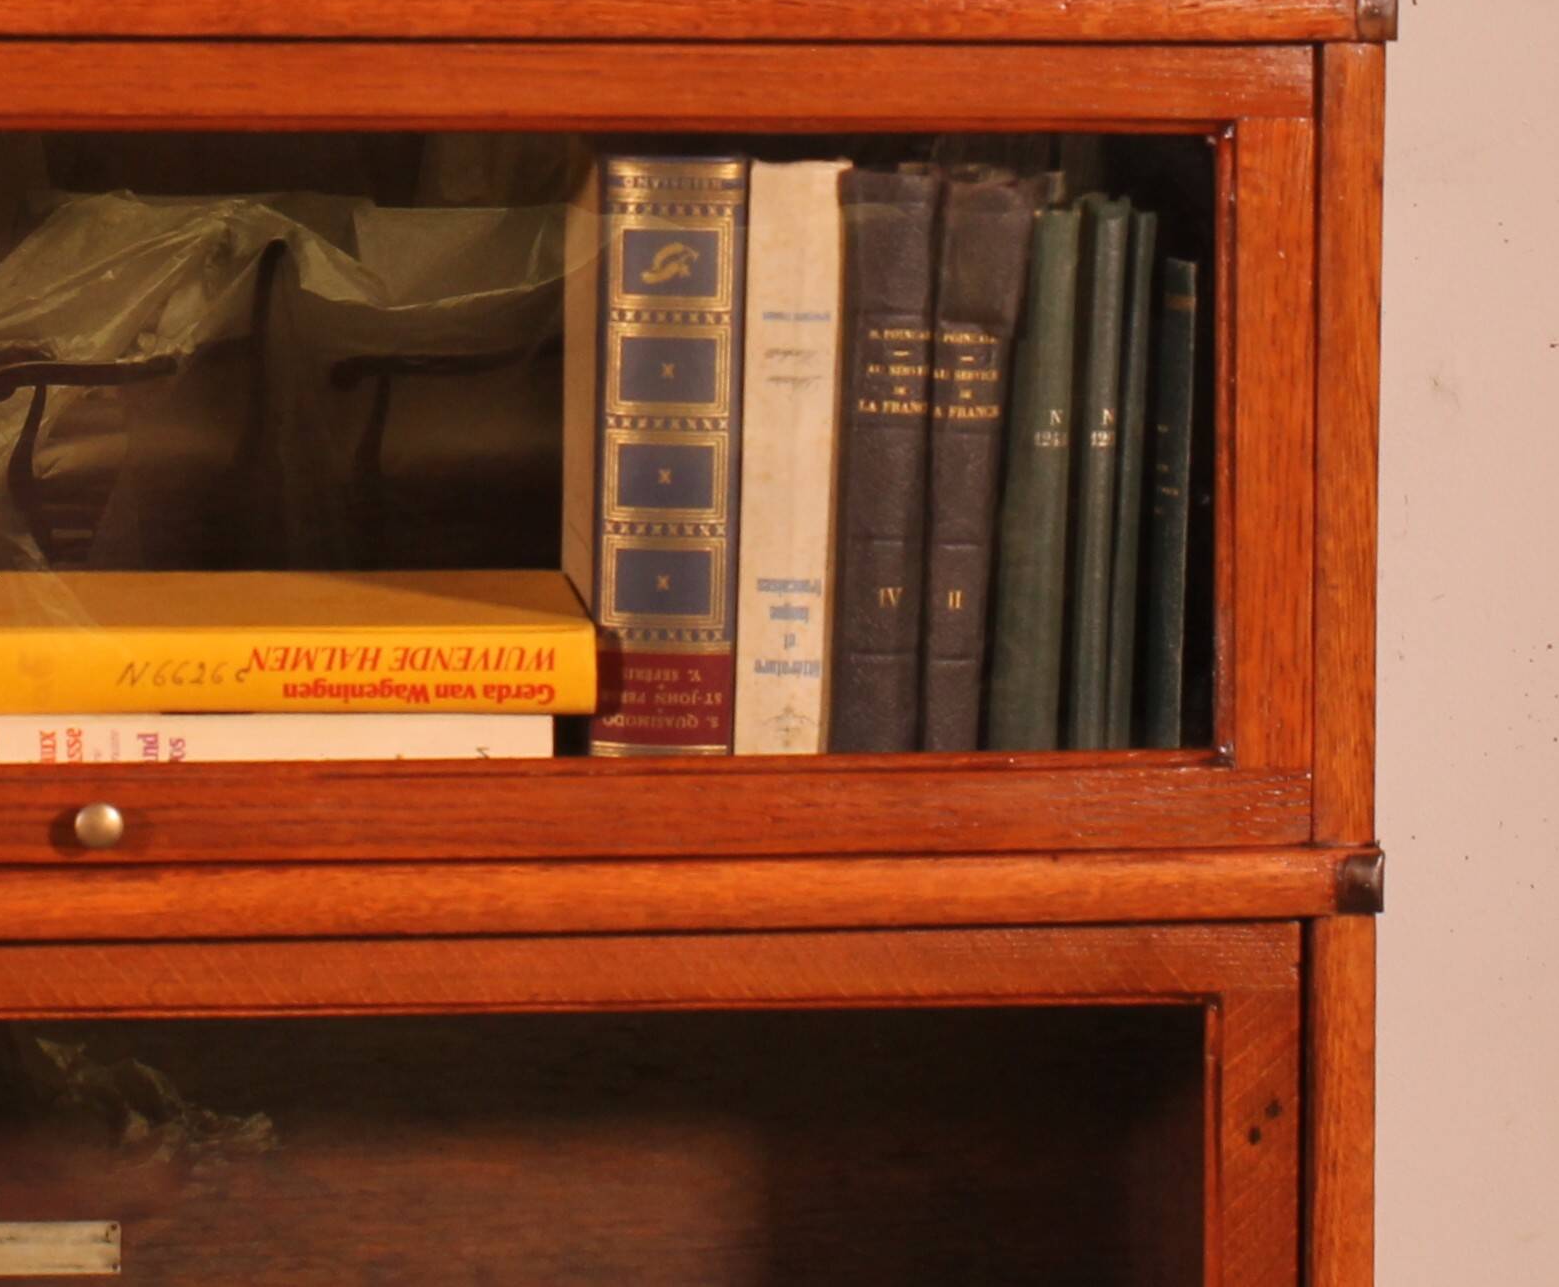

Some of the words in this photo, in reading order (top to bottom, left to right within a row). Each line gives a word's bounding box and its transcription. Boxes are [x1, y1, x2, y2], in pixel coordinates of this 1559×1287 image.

[248, 645, 384, 673] HALMEN
[388, 646, 556, 673] WUIVENDE
[282, 677, 430, 704] Wageningen
[434, 683, 477, 700] van
[482, 682, 556, 705] Gerda
